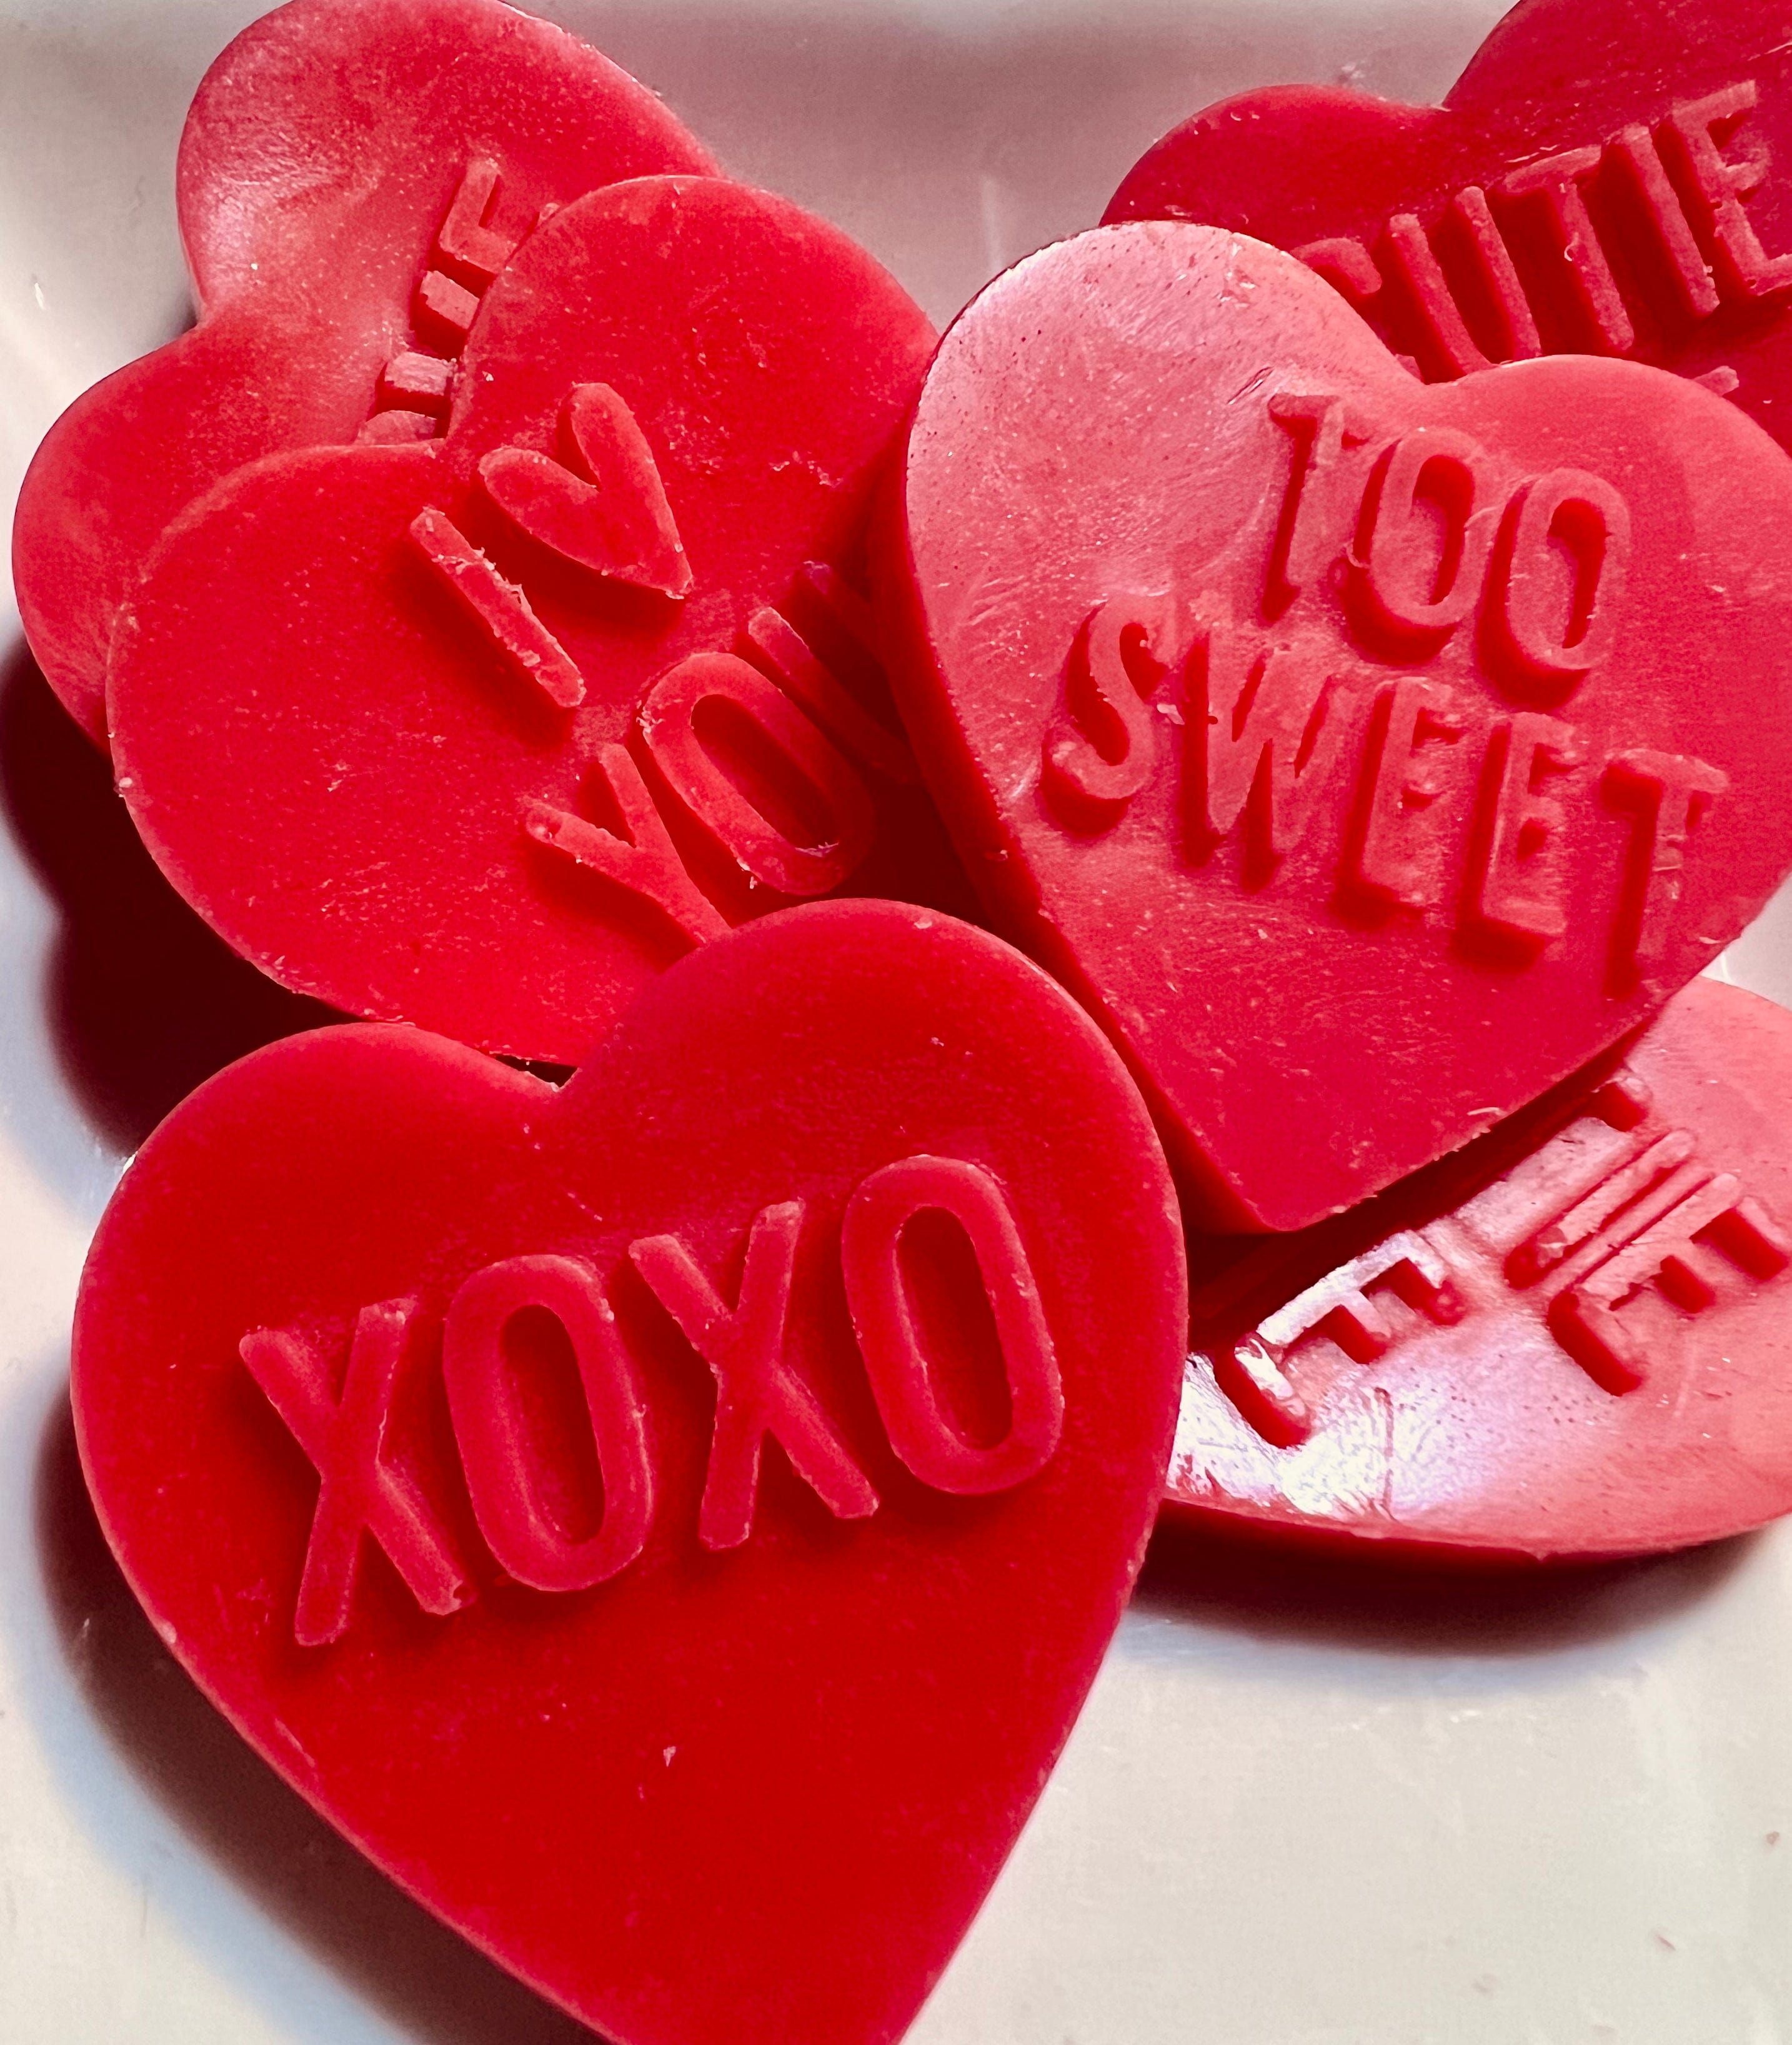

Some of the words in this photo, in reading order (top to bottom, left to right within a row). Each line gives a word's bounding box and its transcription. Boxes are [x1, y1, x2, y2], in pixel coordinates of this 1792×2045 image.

[409, 506, 587, 709] I
[1263, 394, 1633, 675] TOO
[1042, 592, 1731, 995] SWEET
[237, 1153, 1065, 1648] XOXO
